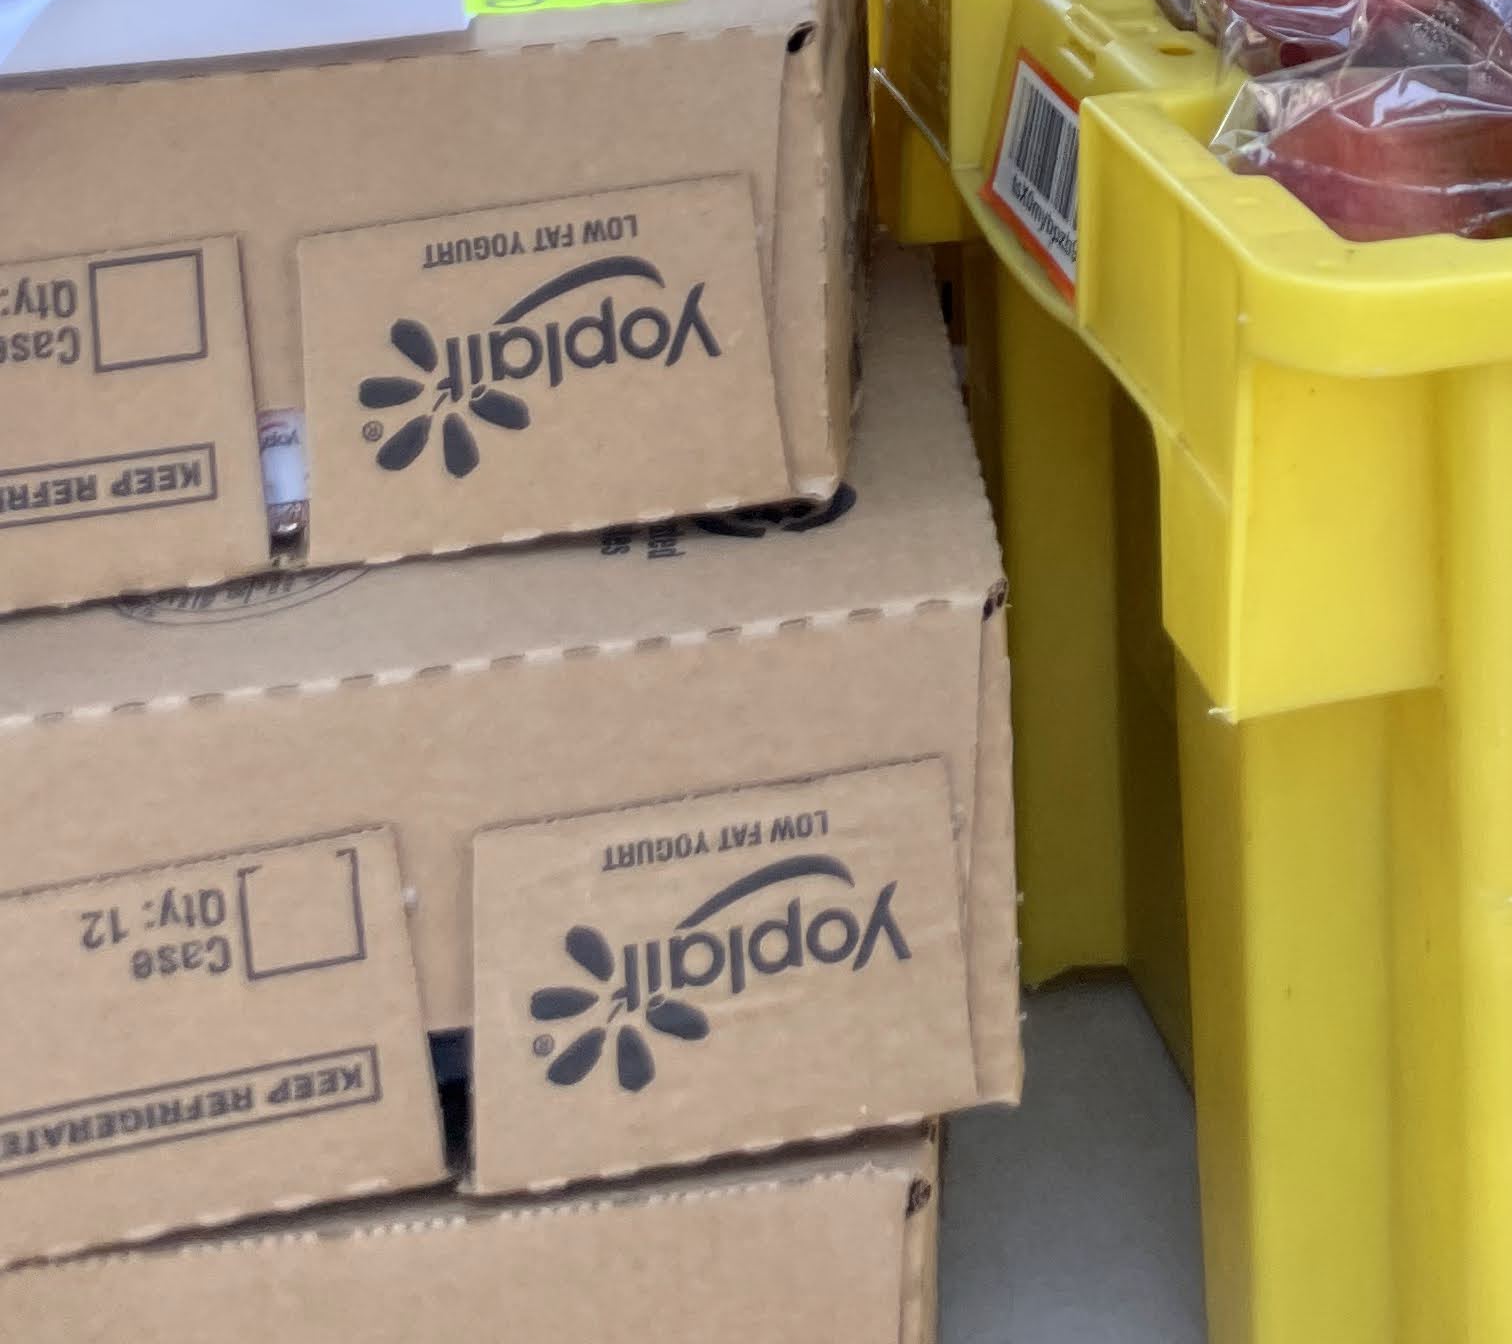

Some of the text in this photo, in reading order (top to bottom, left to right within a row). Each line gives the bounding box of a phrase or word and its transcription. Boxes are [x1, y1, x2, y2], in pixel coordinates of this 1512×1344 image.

[423, 213, 638, 269] LOW FAT YOGURT
[433, 281, 722, 410] Yoplait
[111, 459, 201, 496] KEEP
[602, 810, 829, 872] LOW FAT YOGURT
[79, 886, 228, 950] Qty: 12
[131, 933, 233, 980] Case
[609, 880, 912, 1023] Yoplait
[266, 1061, 365, 1107] KEEP
